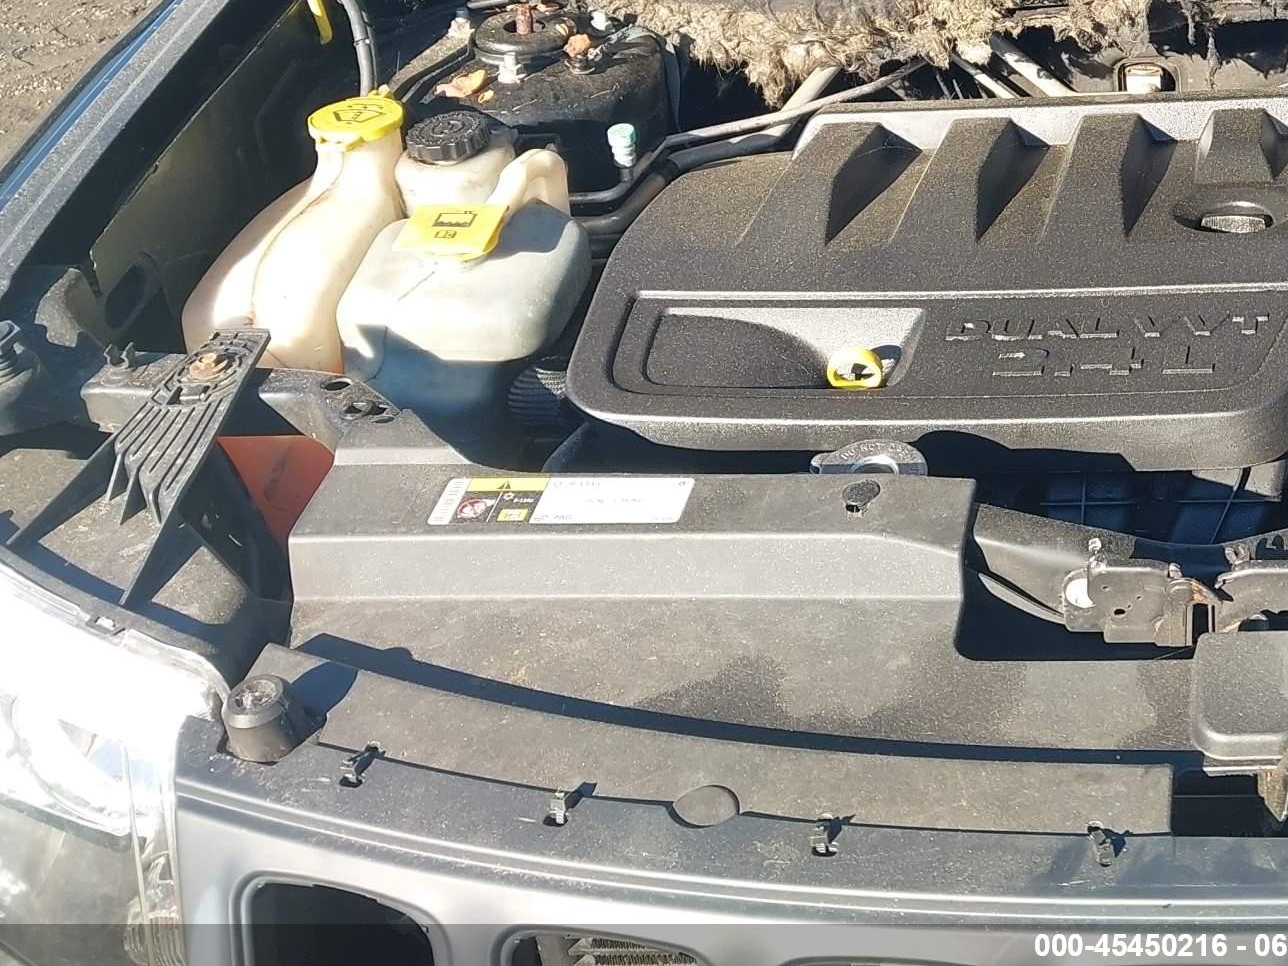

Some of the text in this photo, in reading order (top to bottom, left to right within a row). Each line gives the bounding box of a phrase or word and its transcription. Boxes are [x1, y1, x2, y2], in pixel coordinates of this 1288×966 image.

[944, 312, 1271, 341] DUAL VVT
[991, 344, 1215, 377] 2.4L
